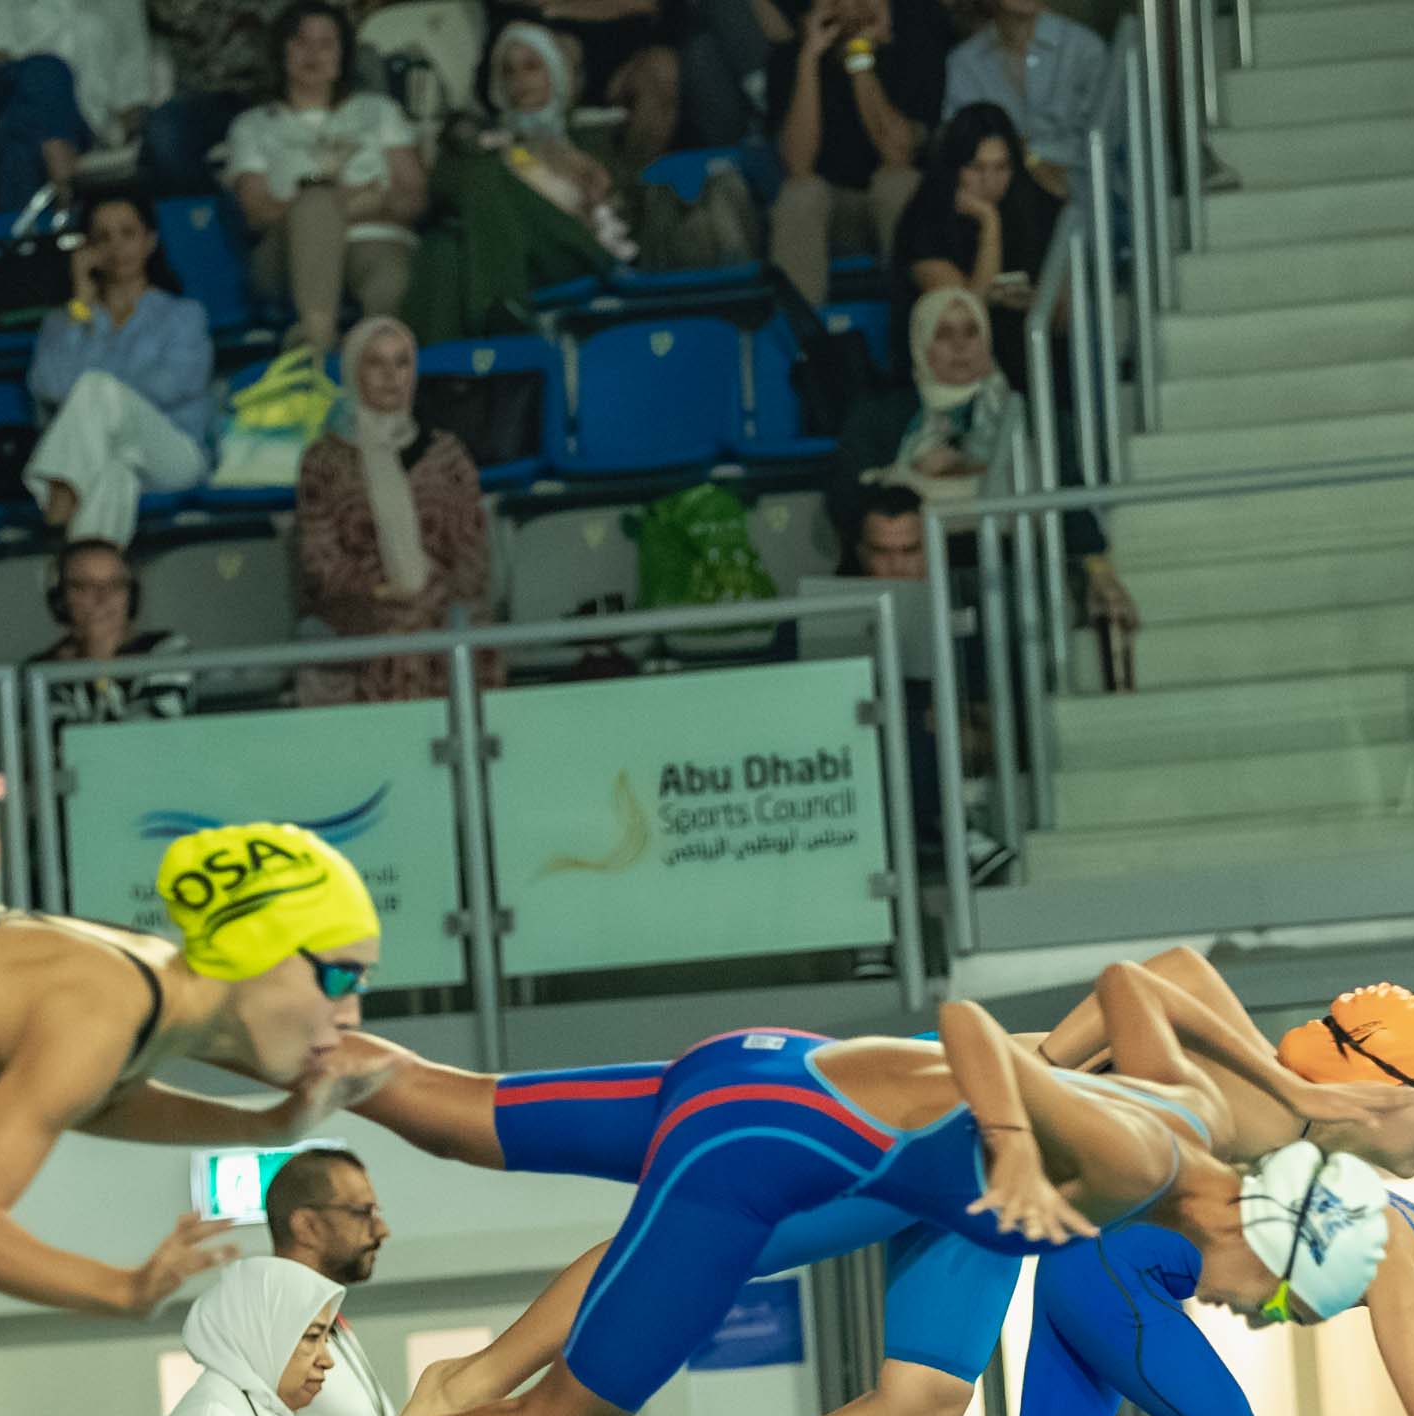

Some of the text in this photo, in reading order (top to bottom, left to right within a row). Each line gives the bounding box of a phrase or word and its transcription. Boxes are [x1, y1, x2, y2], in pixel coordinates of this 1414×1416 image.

[659, 745, 853, 797] Abu Dhabi
[659, 788, 856, 835] Sports Council
